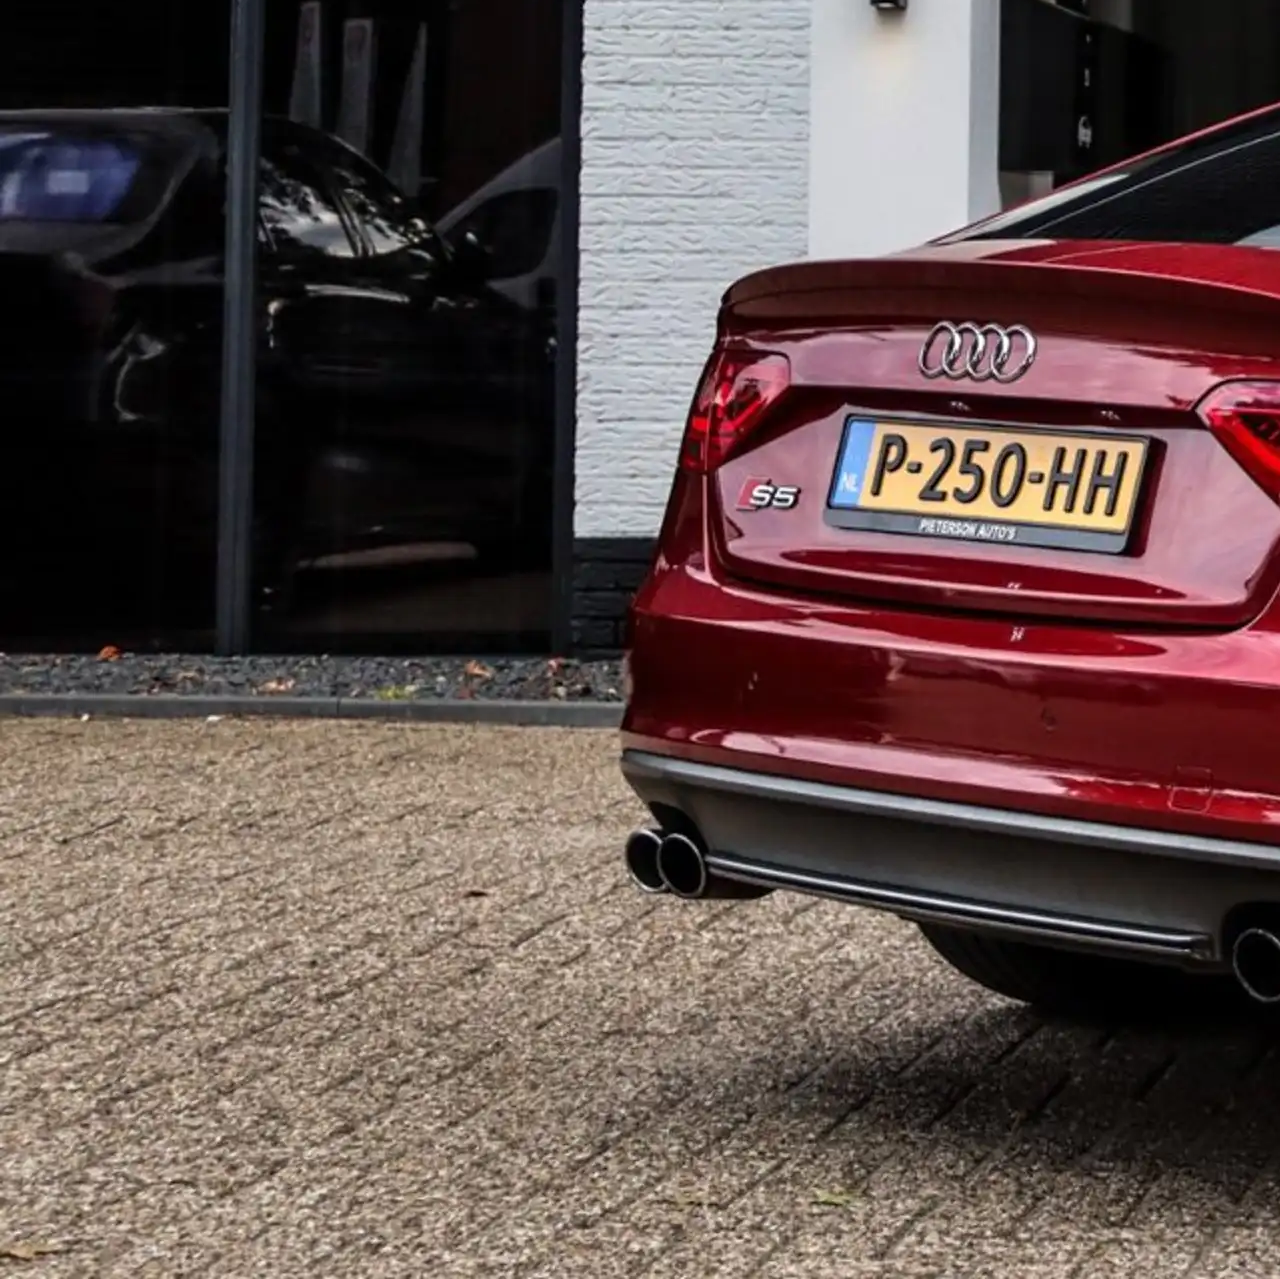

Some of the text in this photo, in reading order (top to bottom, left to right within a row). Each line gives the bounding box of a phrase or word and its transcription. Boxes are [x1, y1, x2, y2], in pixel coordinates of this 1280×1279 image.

[838, 471, 859, 493] NL
[870, 433, 1129, 516] P-250-HH
[749, 484, 800, 509] S5
[919, 519, 977, 537] PIETERSON
